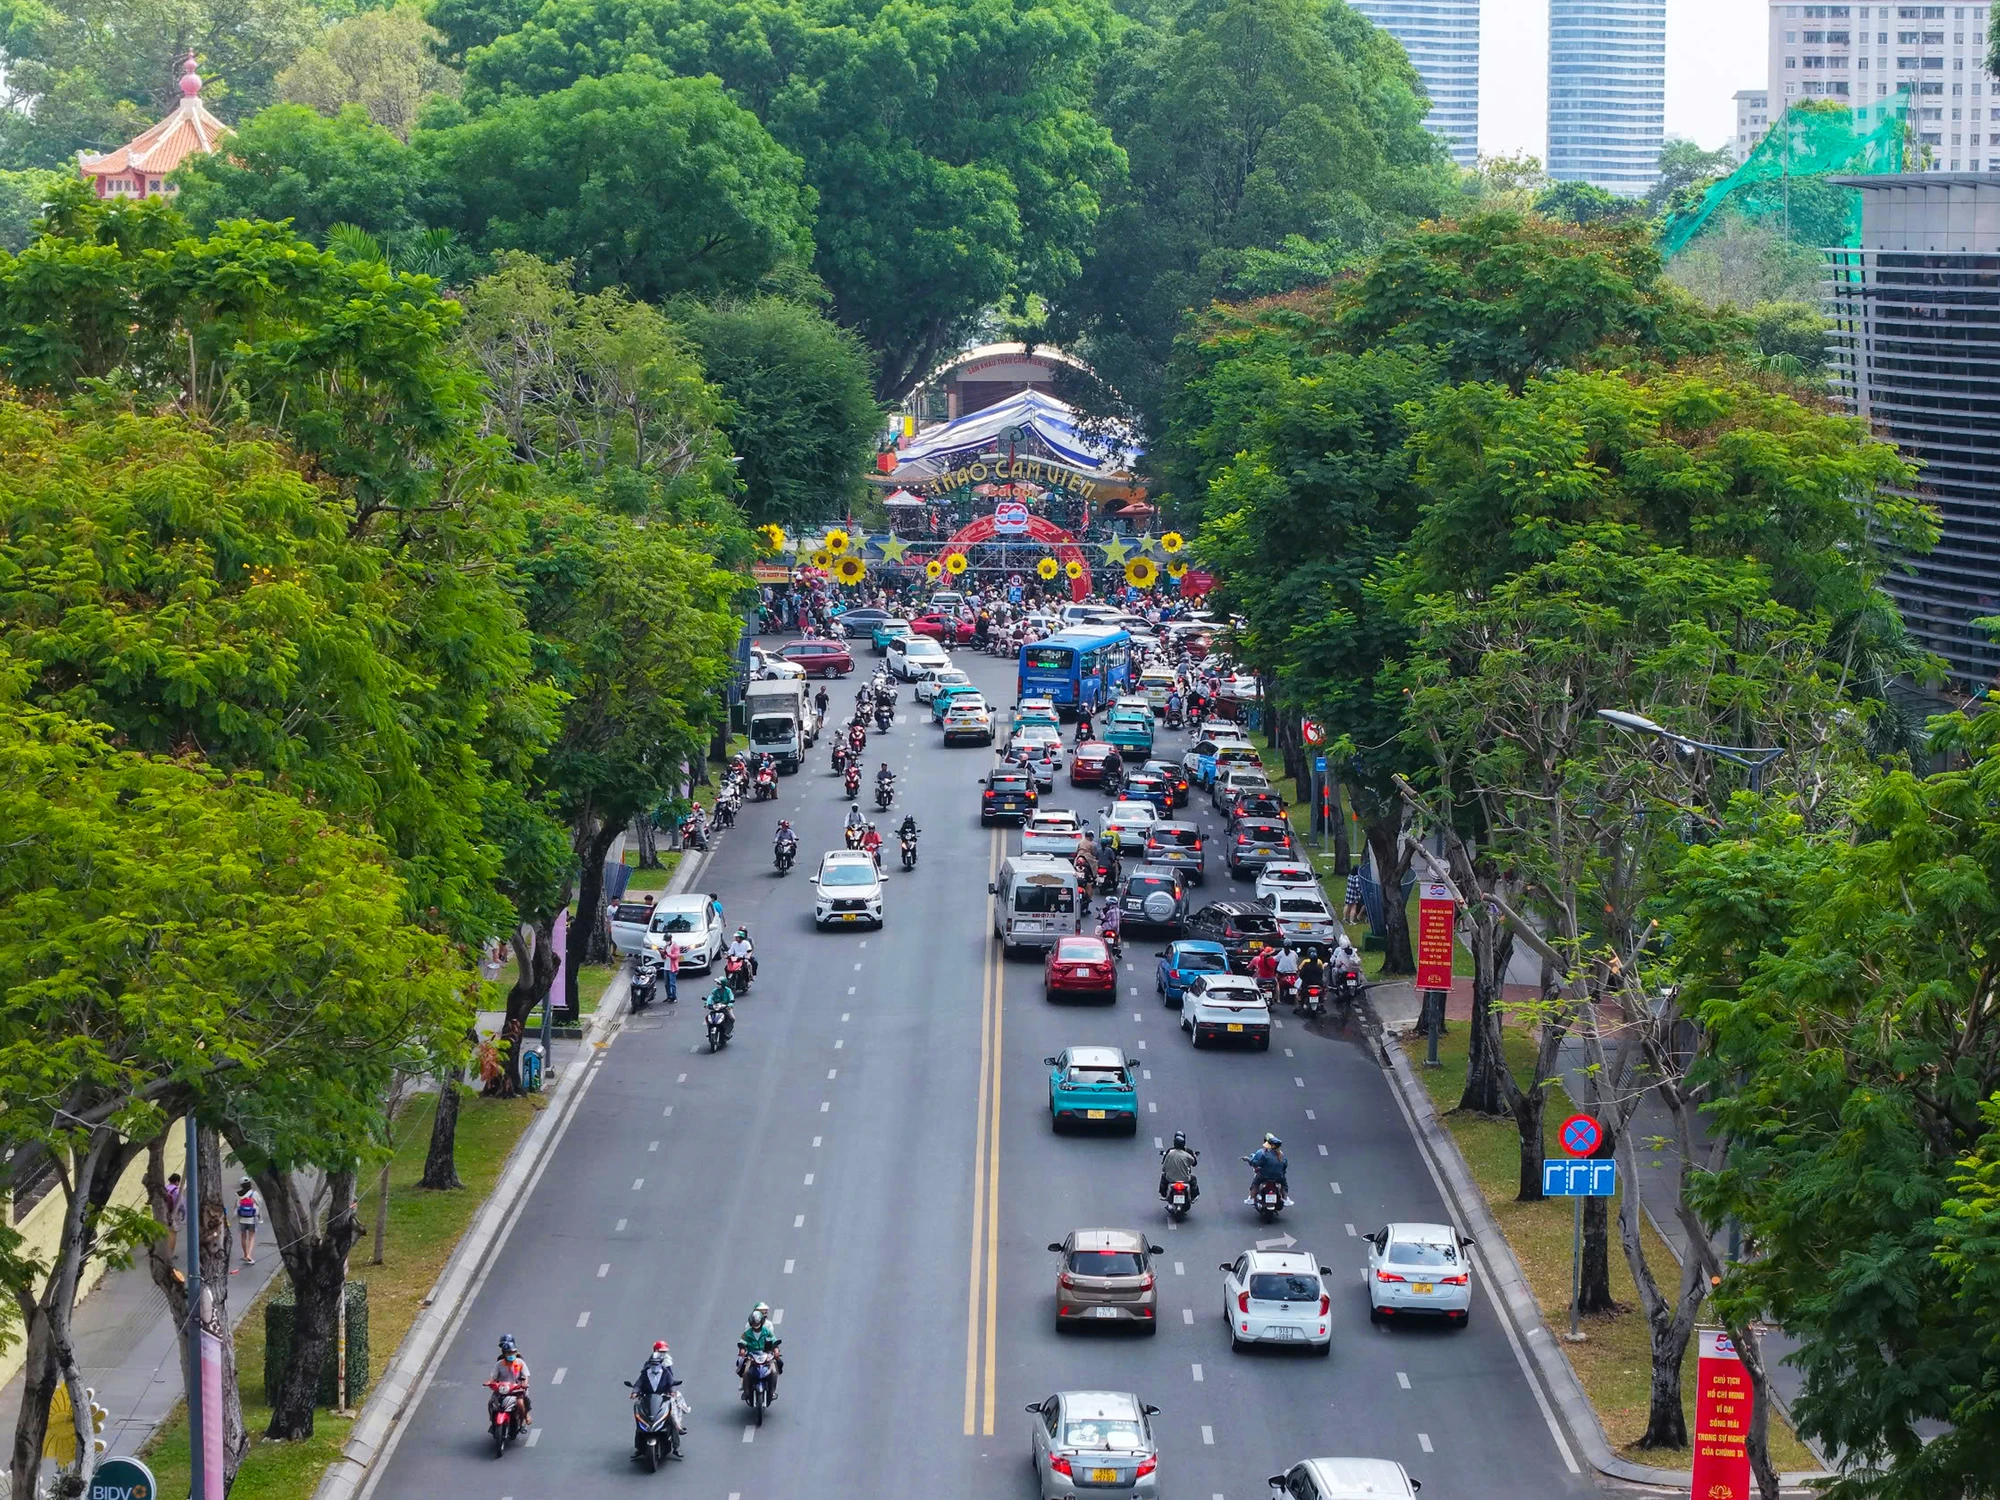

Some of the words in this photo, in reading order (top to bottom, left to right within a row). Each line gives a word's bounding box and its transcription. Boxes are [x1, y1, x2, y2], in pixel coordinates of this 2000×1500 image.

[1713, 1374, 1726, 1385] CHỦ
[1726, 1376, 1741, 1386] TỊCH
[1728, 1391, 1745, 1400] MINH
[1709, 1416, 1726, 1428] SỐNG
[1697, 1433, 1717, 1442] TRONG
[1701, 1445, 1714, 1456] CỦA
[1715, 1447, 1736, 1457] CHÚNG
[1737, 1448, 1744, 1457] TA
[93, 1486, 133, 1500] BIDV
